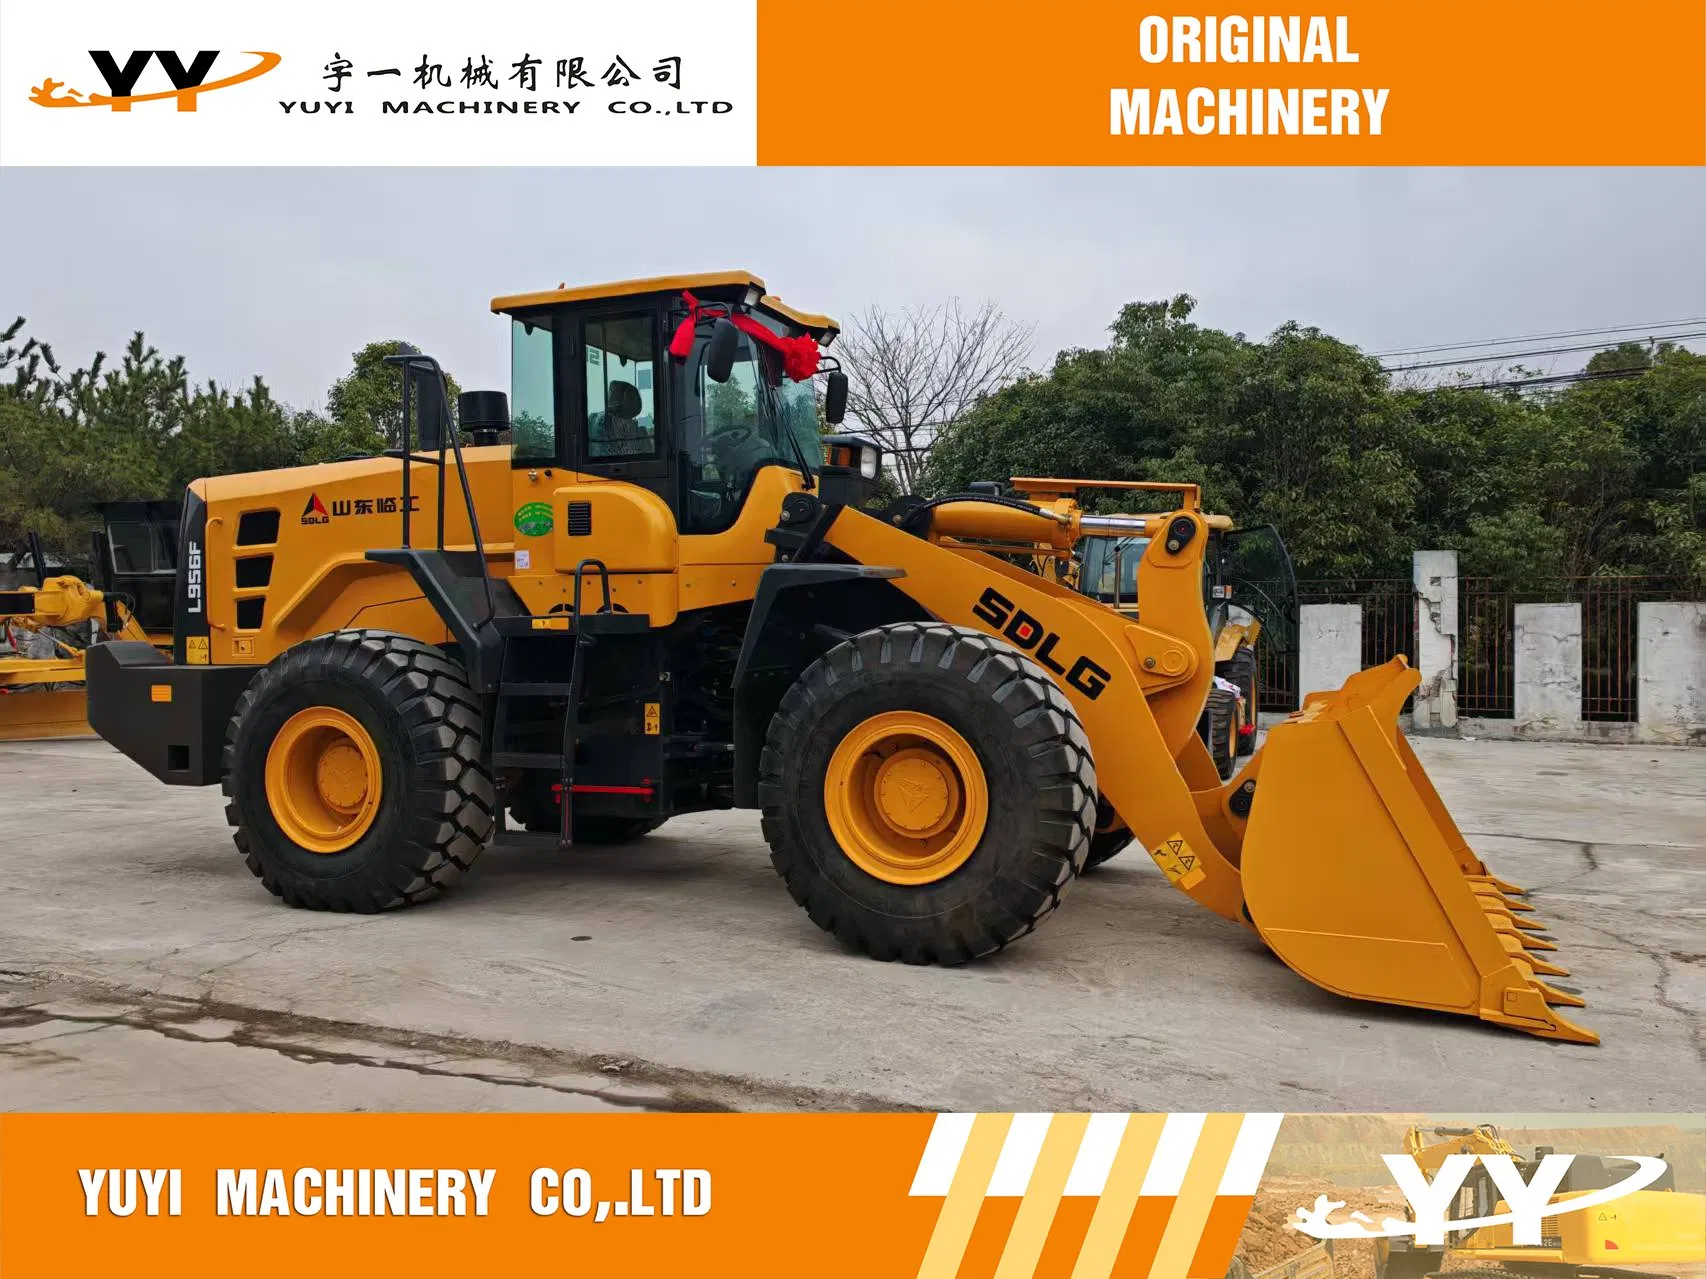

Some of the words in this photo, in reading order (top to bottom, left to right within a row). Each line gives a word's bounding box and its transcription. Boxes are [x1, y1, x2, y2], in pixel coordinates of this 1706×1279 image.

[301, 515, 329, 525] SDLG
[187, 541, 202, 613] L956F
[972, 586, 1112, 701] SDLG
